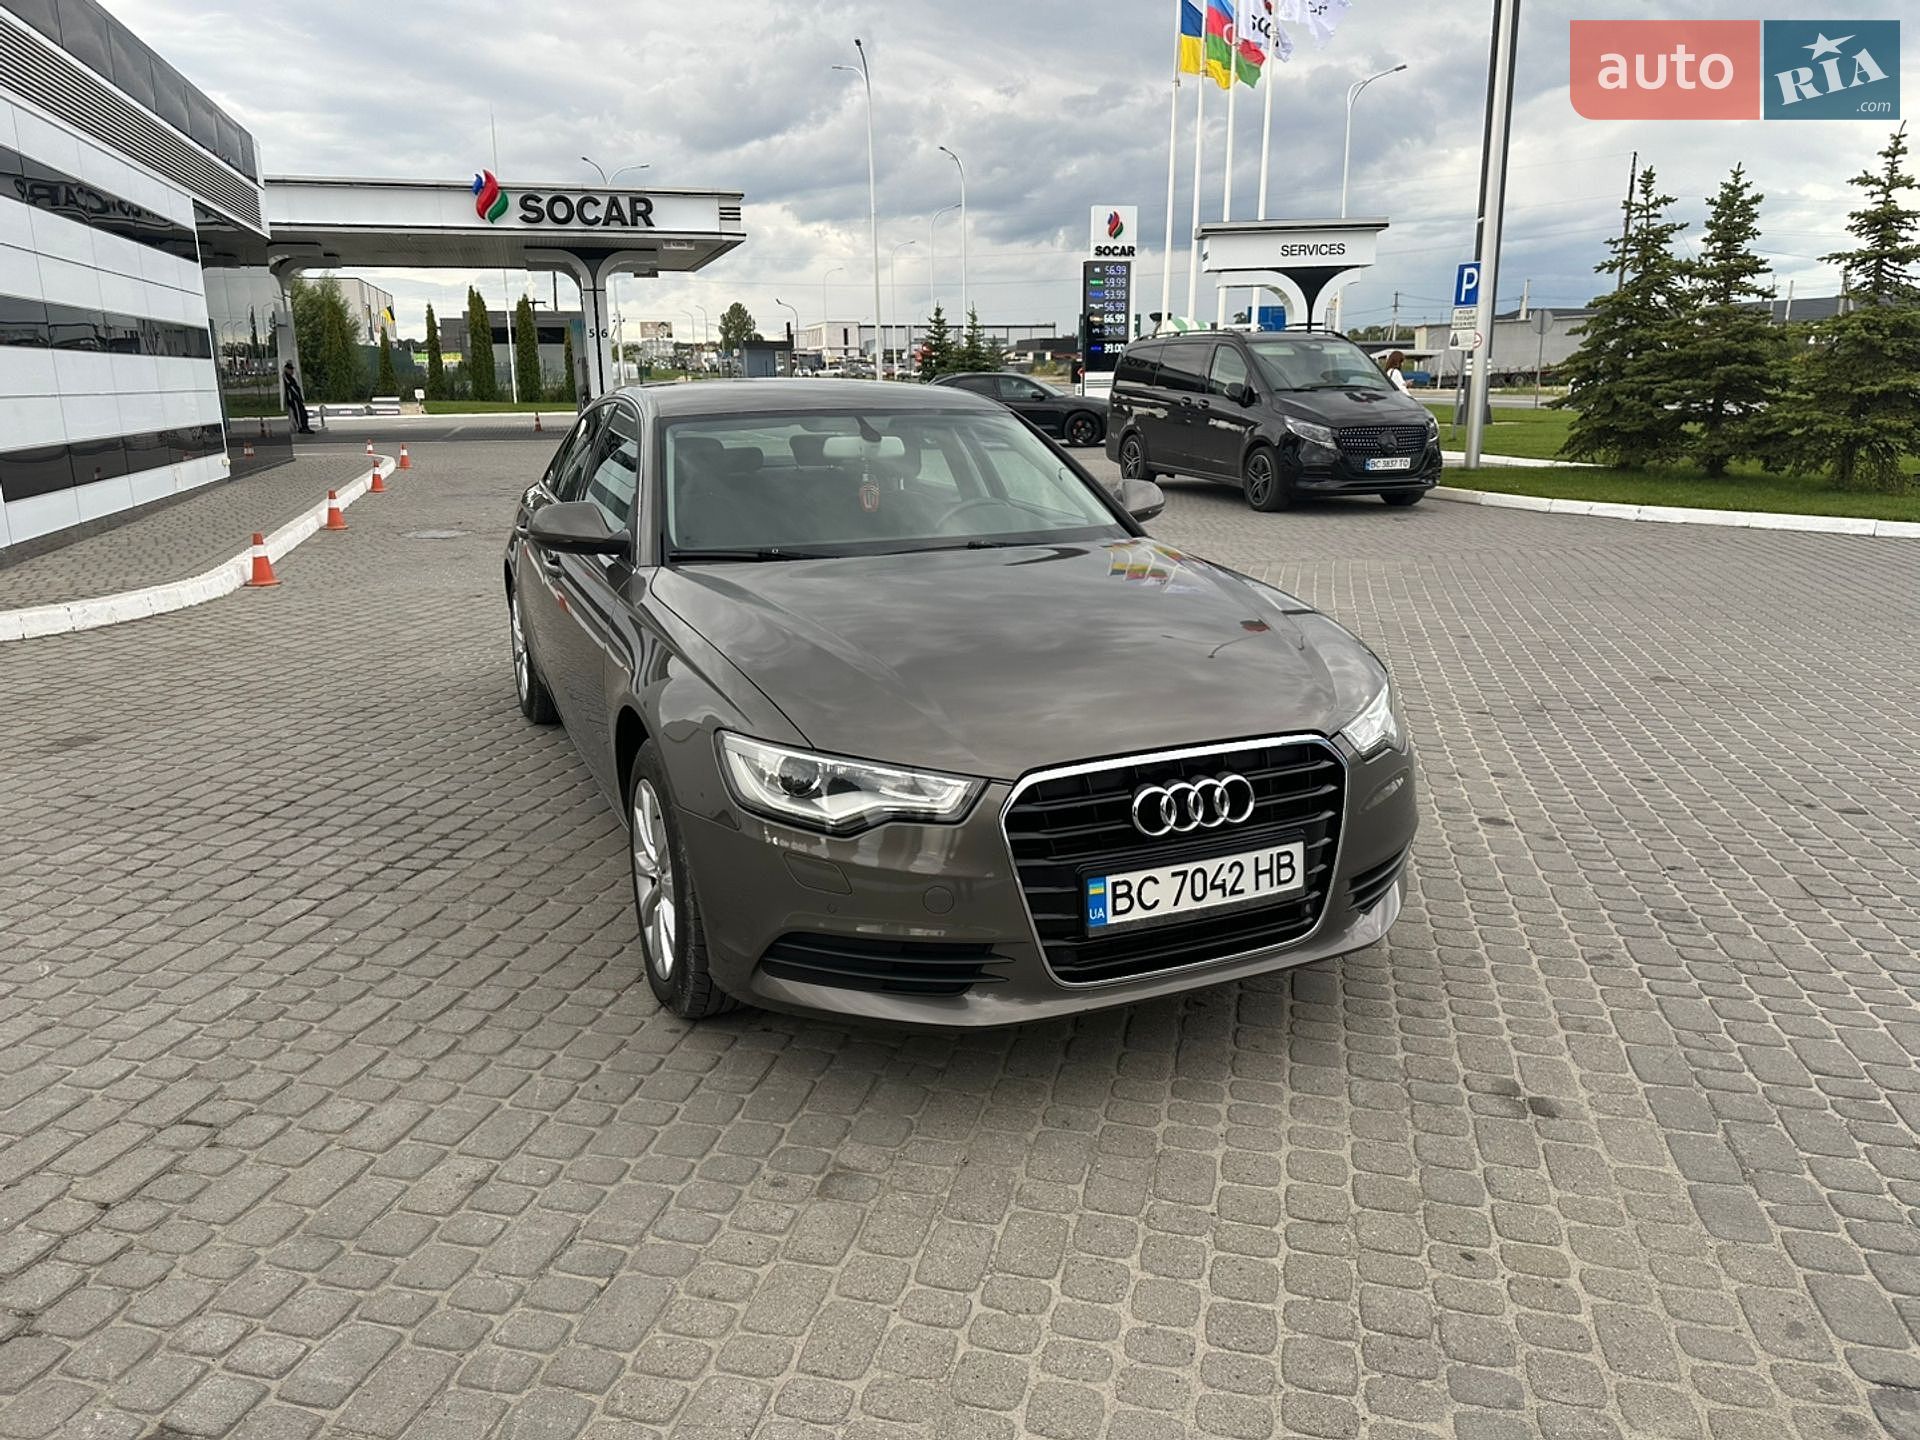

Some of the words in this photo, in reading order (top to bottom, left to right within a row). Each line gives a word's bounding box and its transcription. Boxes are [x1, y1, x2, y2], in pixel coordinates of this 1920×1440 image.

[518, 192, 655, 227] SOCAR
[1095, 245, 1136, 257] SOCAR
[1280, 242, 1346, 257] SERVICES
[1460, 267, 1478, 303] P
[1103, 313, 1126, 324] 66.99
[588, 328, 595, 338] 5
[601, 328, 608, 338] 6
[1110, 875, 1160, 917] BC
[1171, 860, 1245, 907] 7042
[1254, 850, 1296, 891] HB
[1089, 907, 1105, 920] UA
